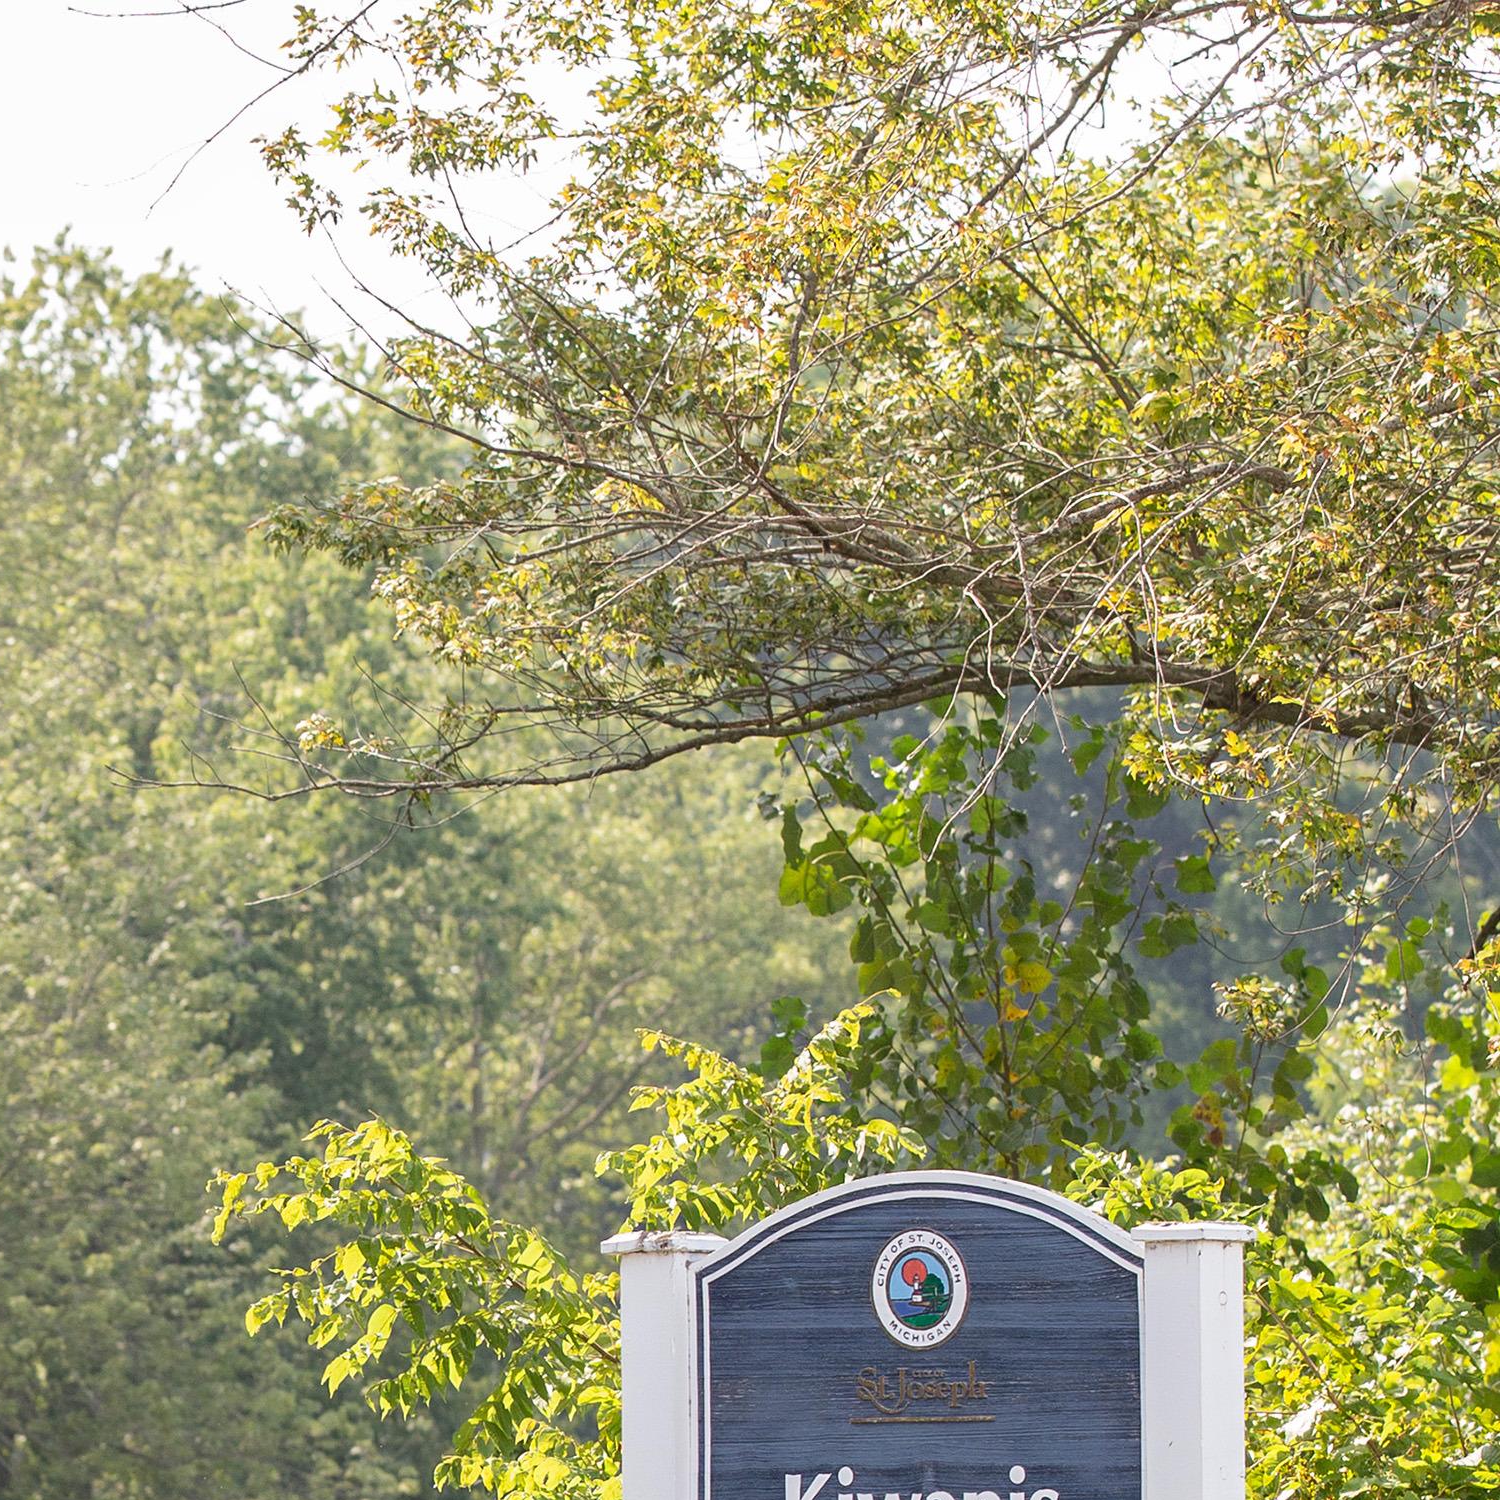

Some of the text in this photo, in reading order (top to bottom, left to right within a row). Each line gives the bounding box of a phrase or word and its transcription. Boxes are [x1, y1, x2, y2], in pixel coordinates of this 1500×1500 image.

[876, 1234, 962, 1287] CITY OF ST. JOSEPH
[889, 1320, 952, 1342] MICHIGAN
[889, 1360, 990, 1414] Joseph
